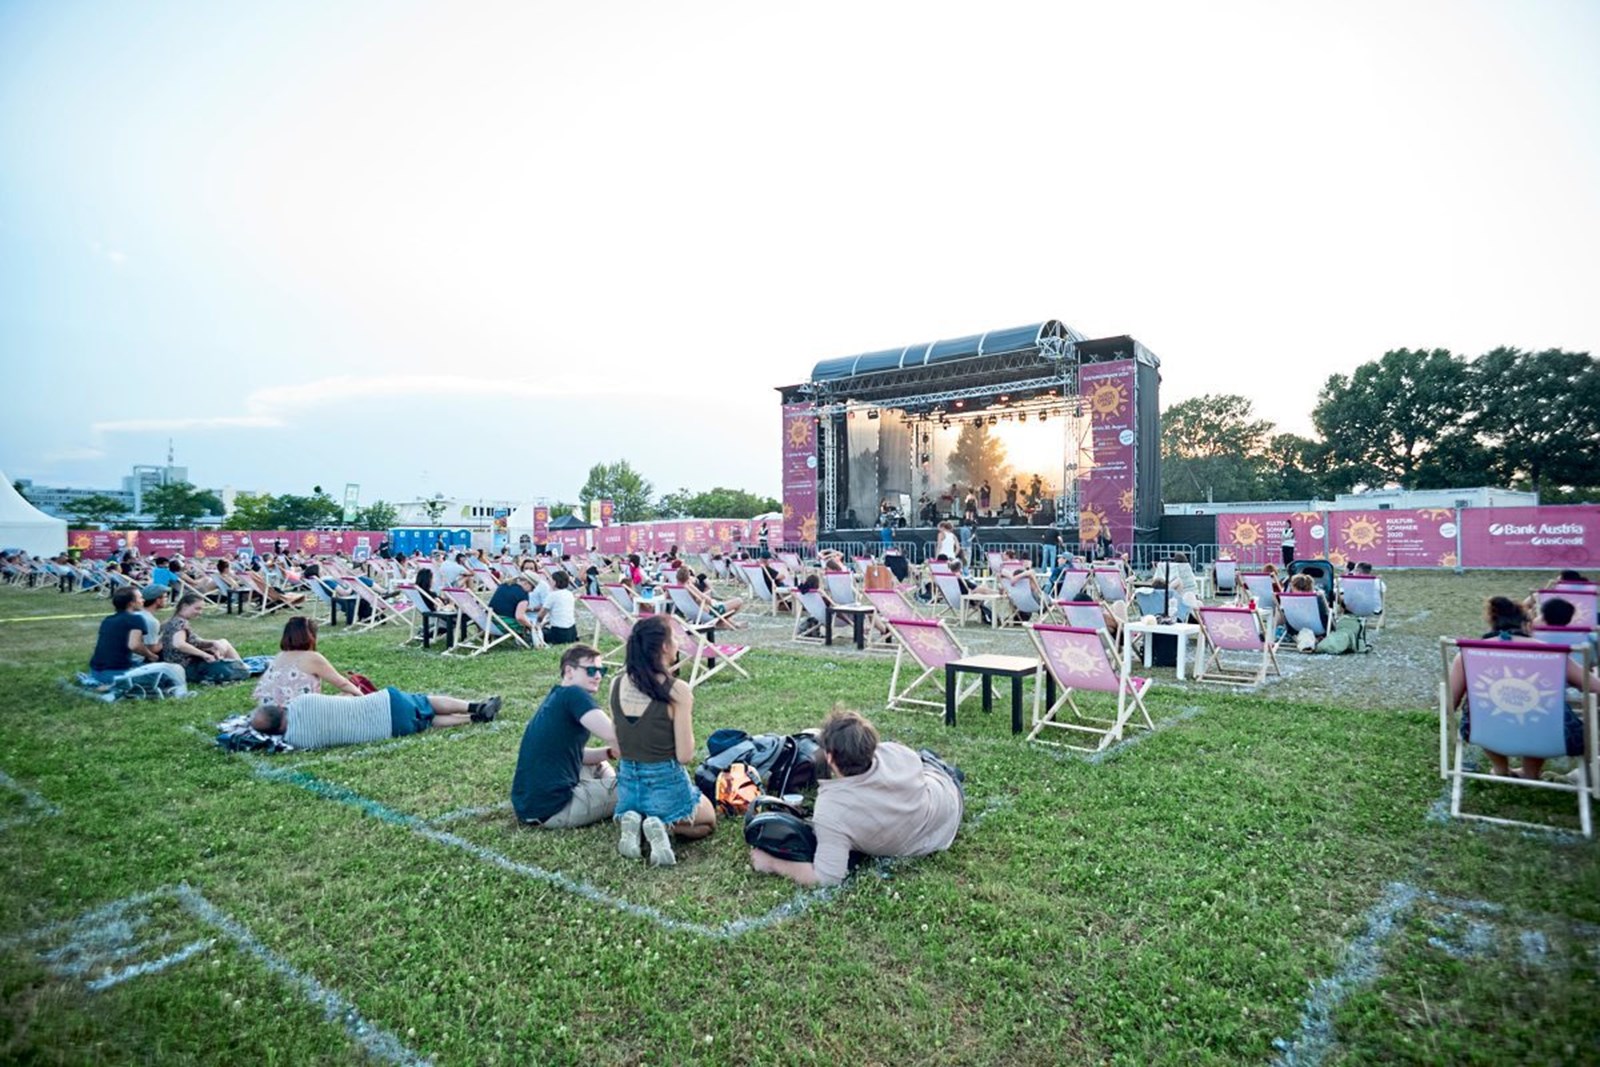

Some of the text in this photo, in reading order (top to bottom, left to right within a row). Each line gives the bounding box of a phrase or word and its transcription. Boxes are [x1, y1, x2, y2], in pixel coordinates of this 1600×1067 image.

[1504, 523, 1584, 535] Bank Austria
[1542, 536, 1584, 545] UniCredit
